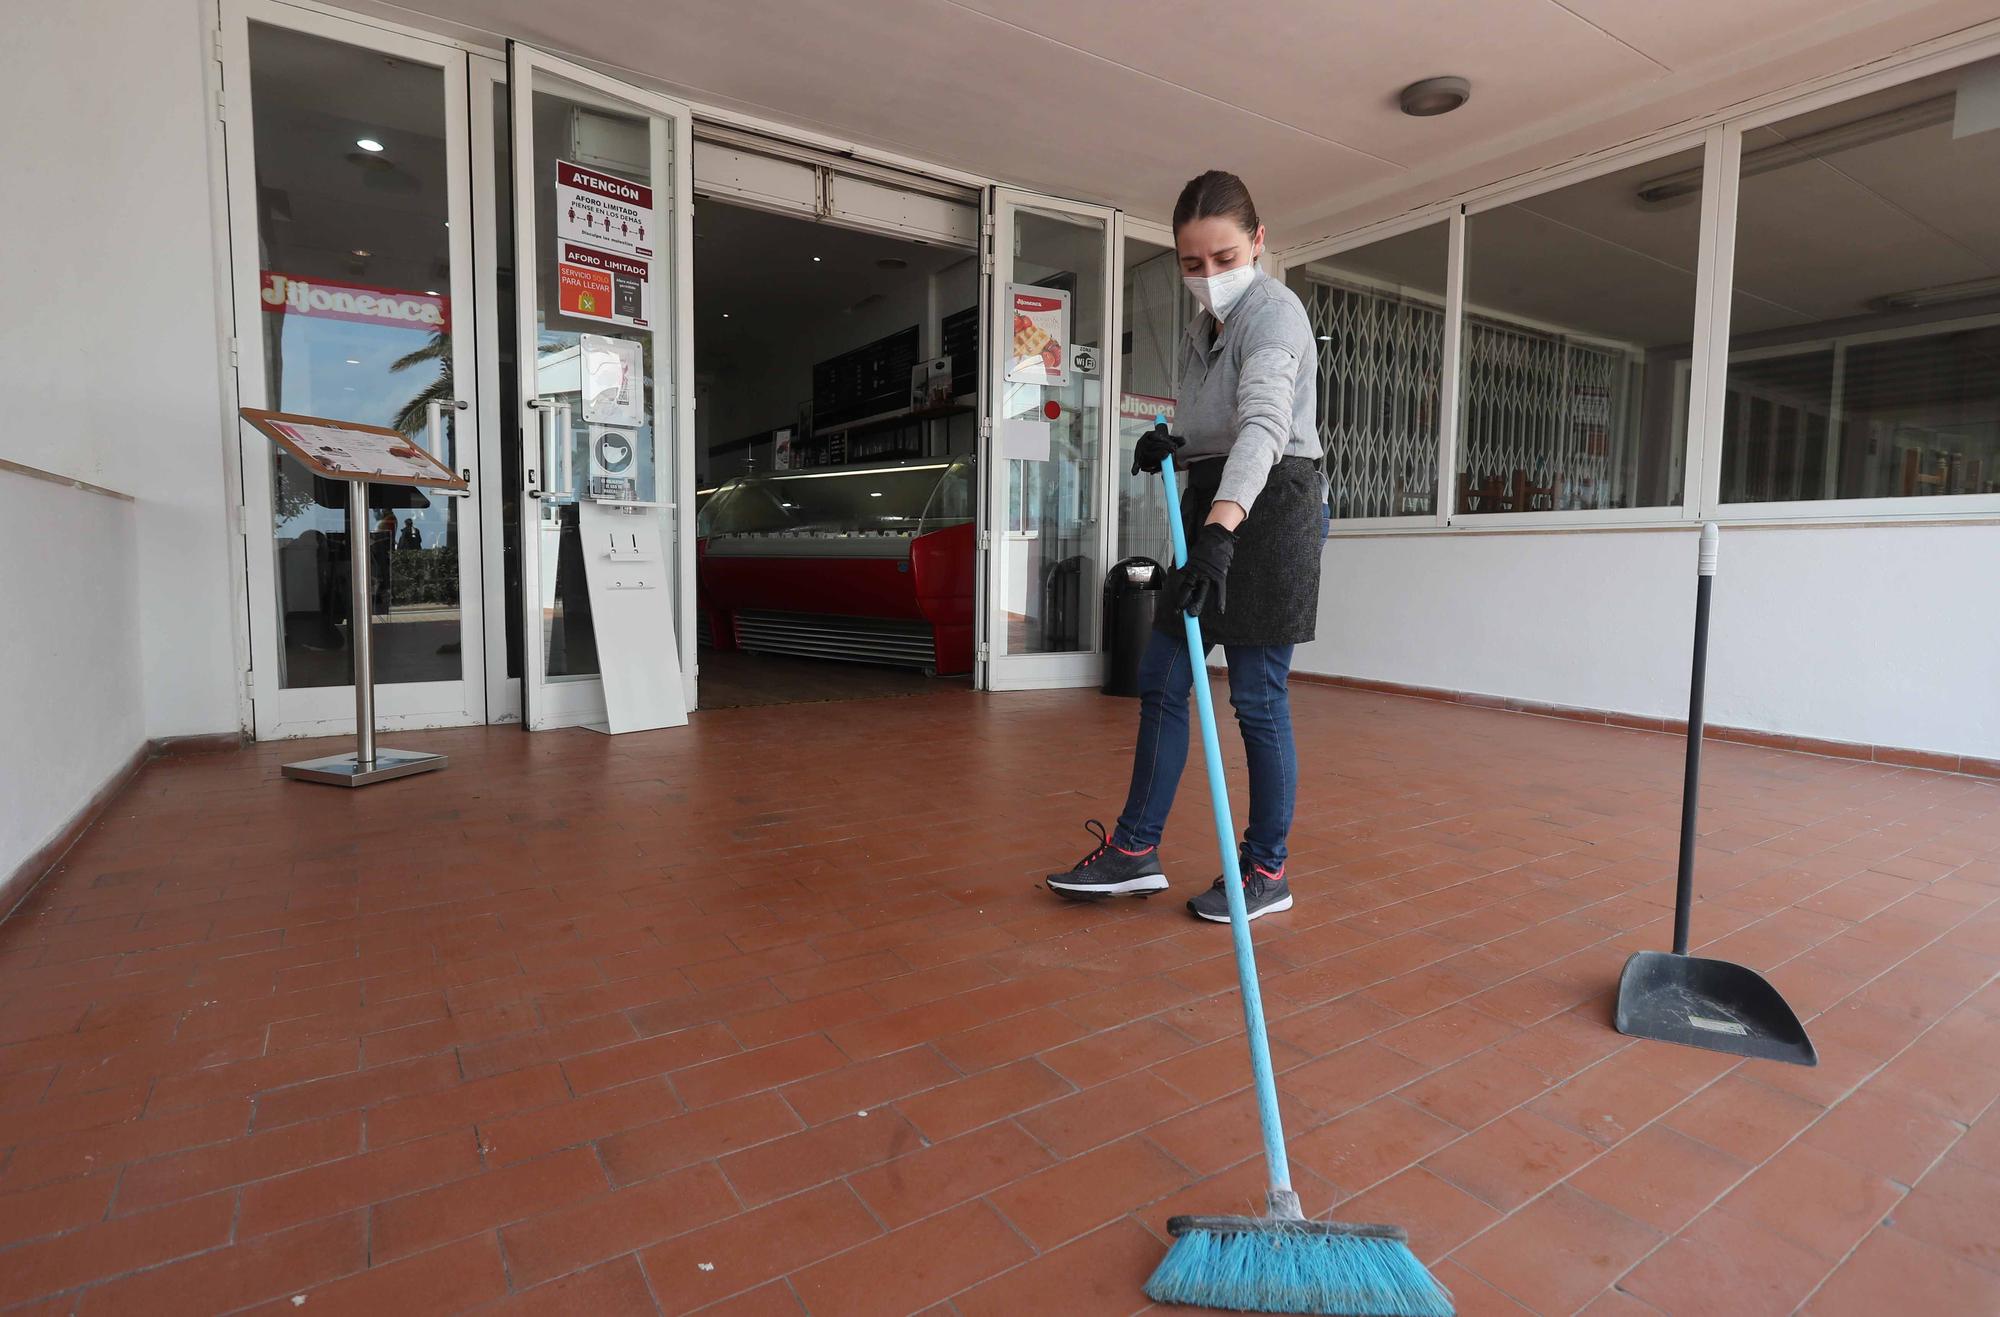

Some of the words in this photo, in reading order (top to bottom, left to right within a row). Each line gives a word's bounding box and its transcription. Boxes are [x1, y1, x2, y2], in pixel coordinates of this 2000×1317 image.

[573, 172, 639, 200] ATENCIÓN
[571, 200, 594, 212] PIENSE
[595, 207, 605, 215] EN
[606, 210, 619, 219] LOS
[575, 194, 601, 207] AFORO
[603, 201, 638, 216] LIMITADO
[561, 268, 592, 280] SERVICIO
[568, 252, 600, 265] AFORO
[604, 260, 646, 275] LIMITADO
[561, 277, 582, 287] PARA
[583, 281, 610, 293] LLEVAR
[262, 275, 445, 325] Jijonenca
[1121, 394, 1175, 418] Jijonen
